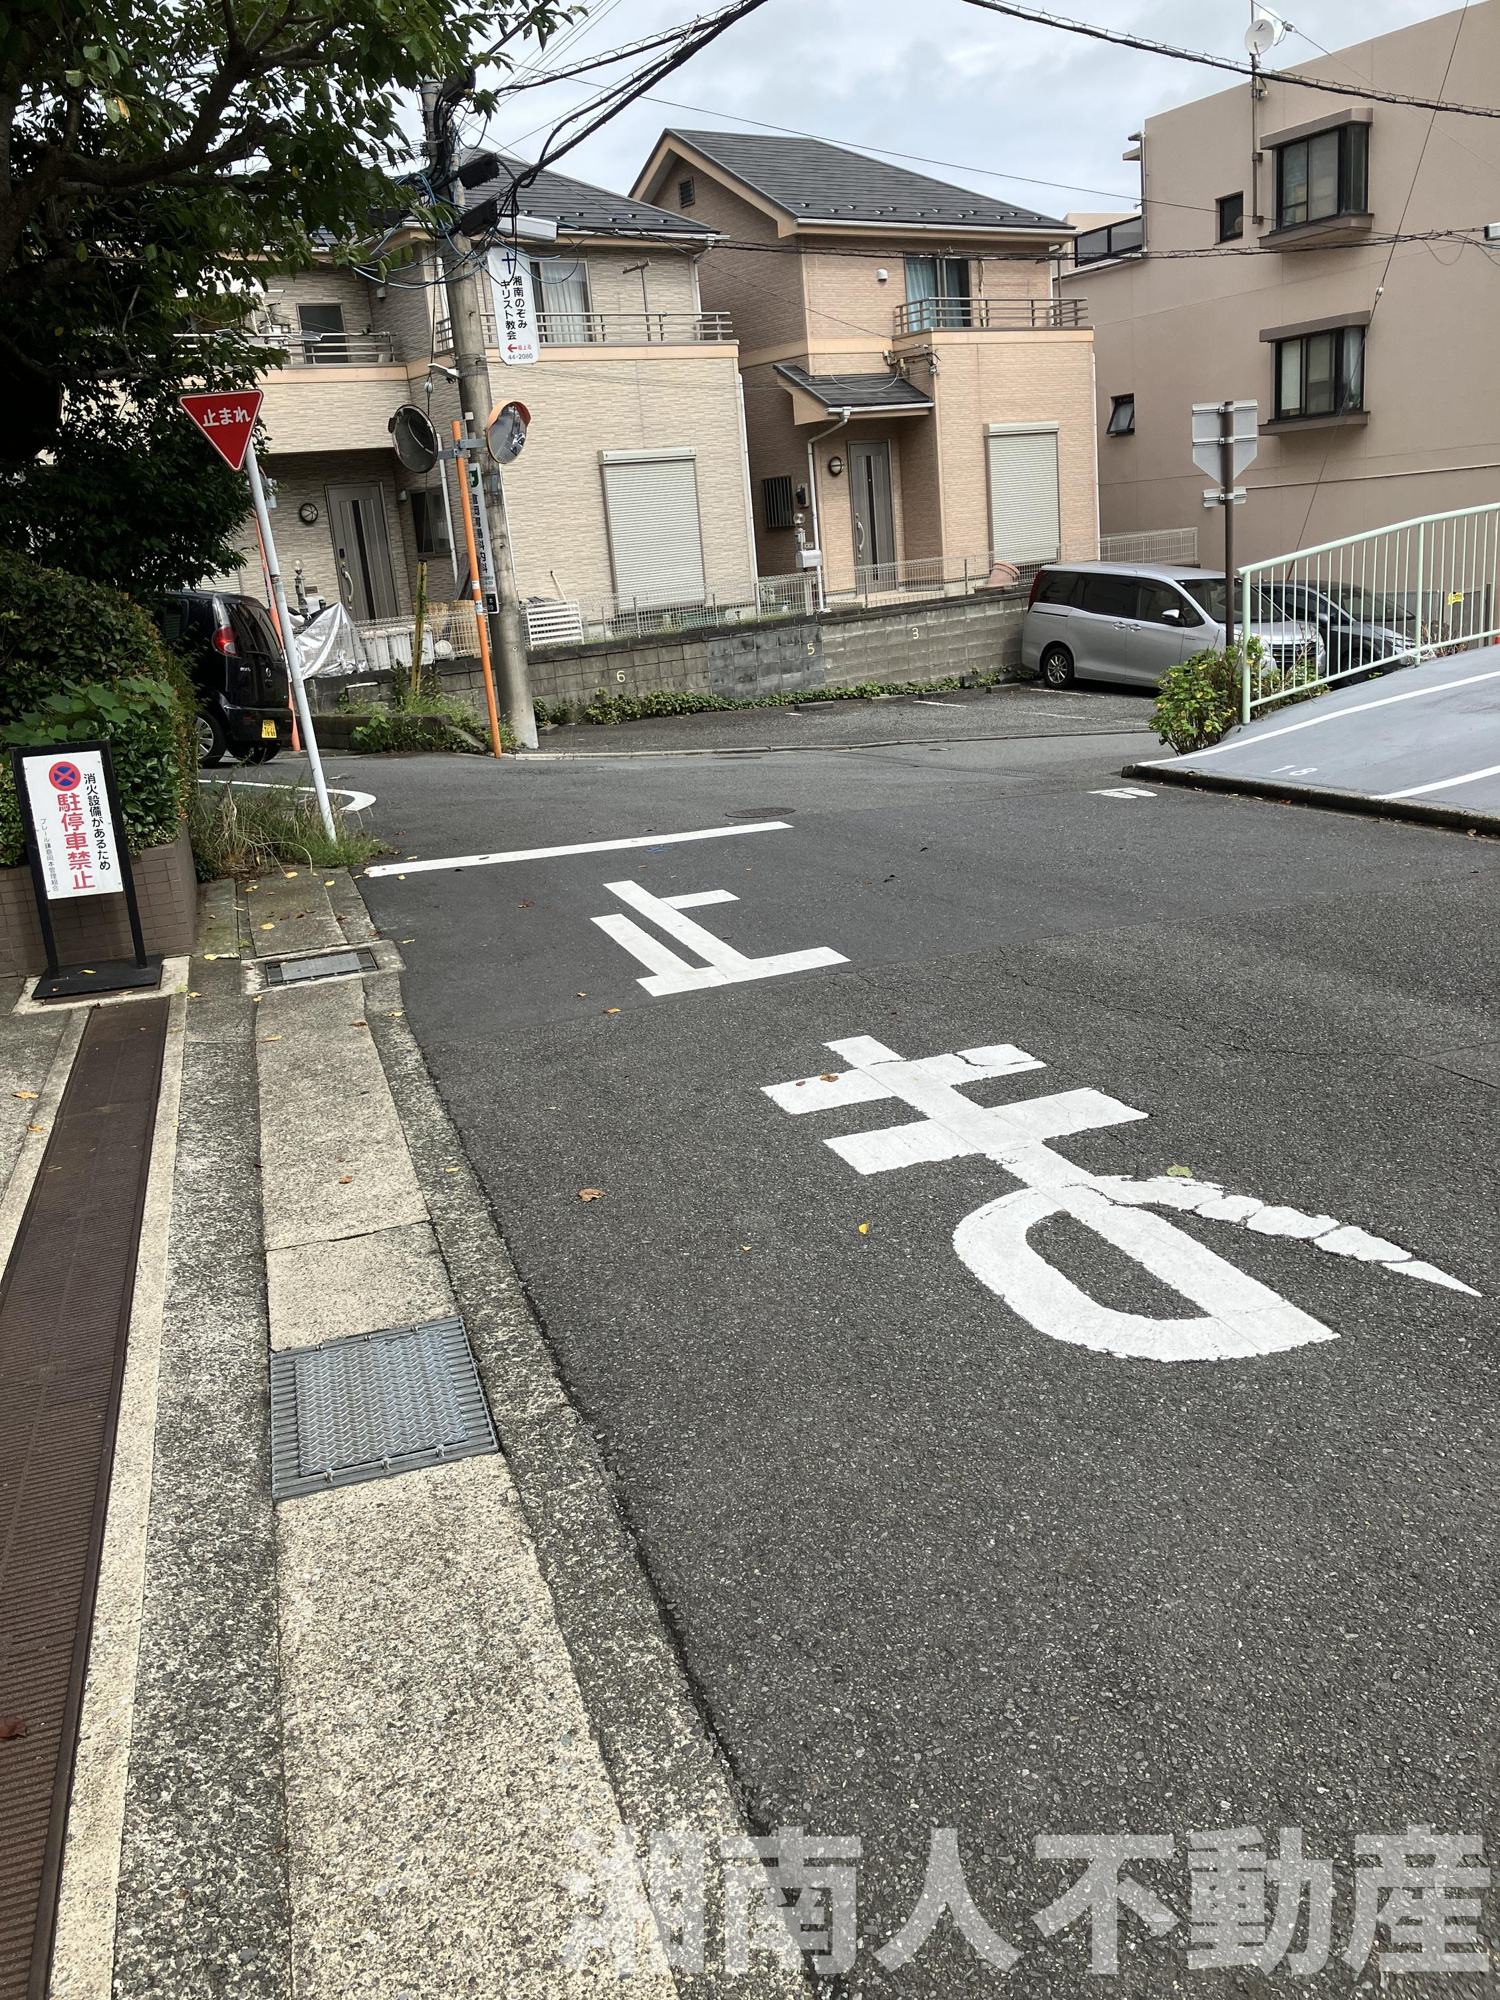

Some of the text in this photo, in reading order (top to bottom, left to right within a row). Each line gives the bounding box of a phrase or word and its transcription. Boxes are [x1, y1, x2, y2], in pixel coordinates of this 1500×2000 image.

[501, 279, 517, 341] キリスト教会
[512, 275, 528, 329] 湘南のぞみ
[202, 406, 251, 427] 止まれ
[911, 627, 920, 640] 3
[806, 642, 816, 656] 5
[616, 670, 626, 683] 6
[1270, 764, 1318, 776] 18
[84, 773, 111, 872] 消火設備があるため
[56, 792, 96, 890] 駐停車禁止
